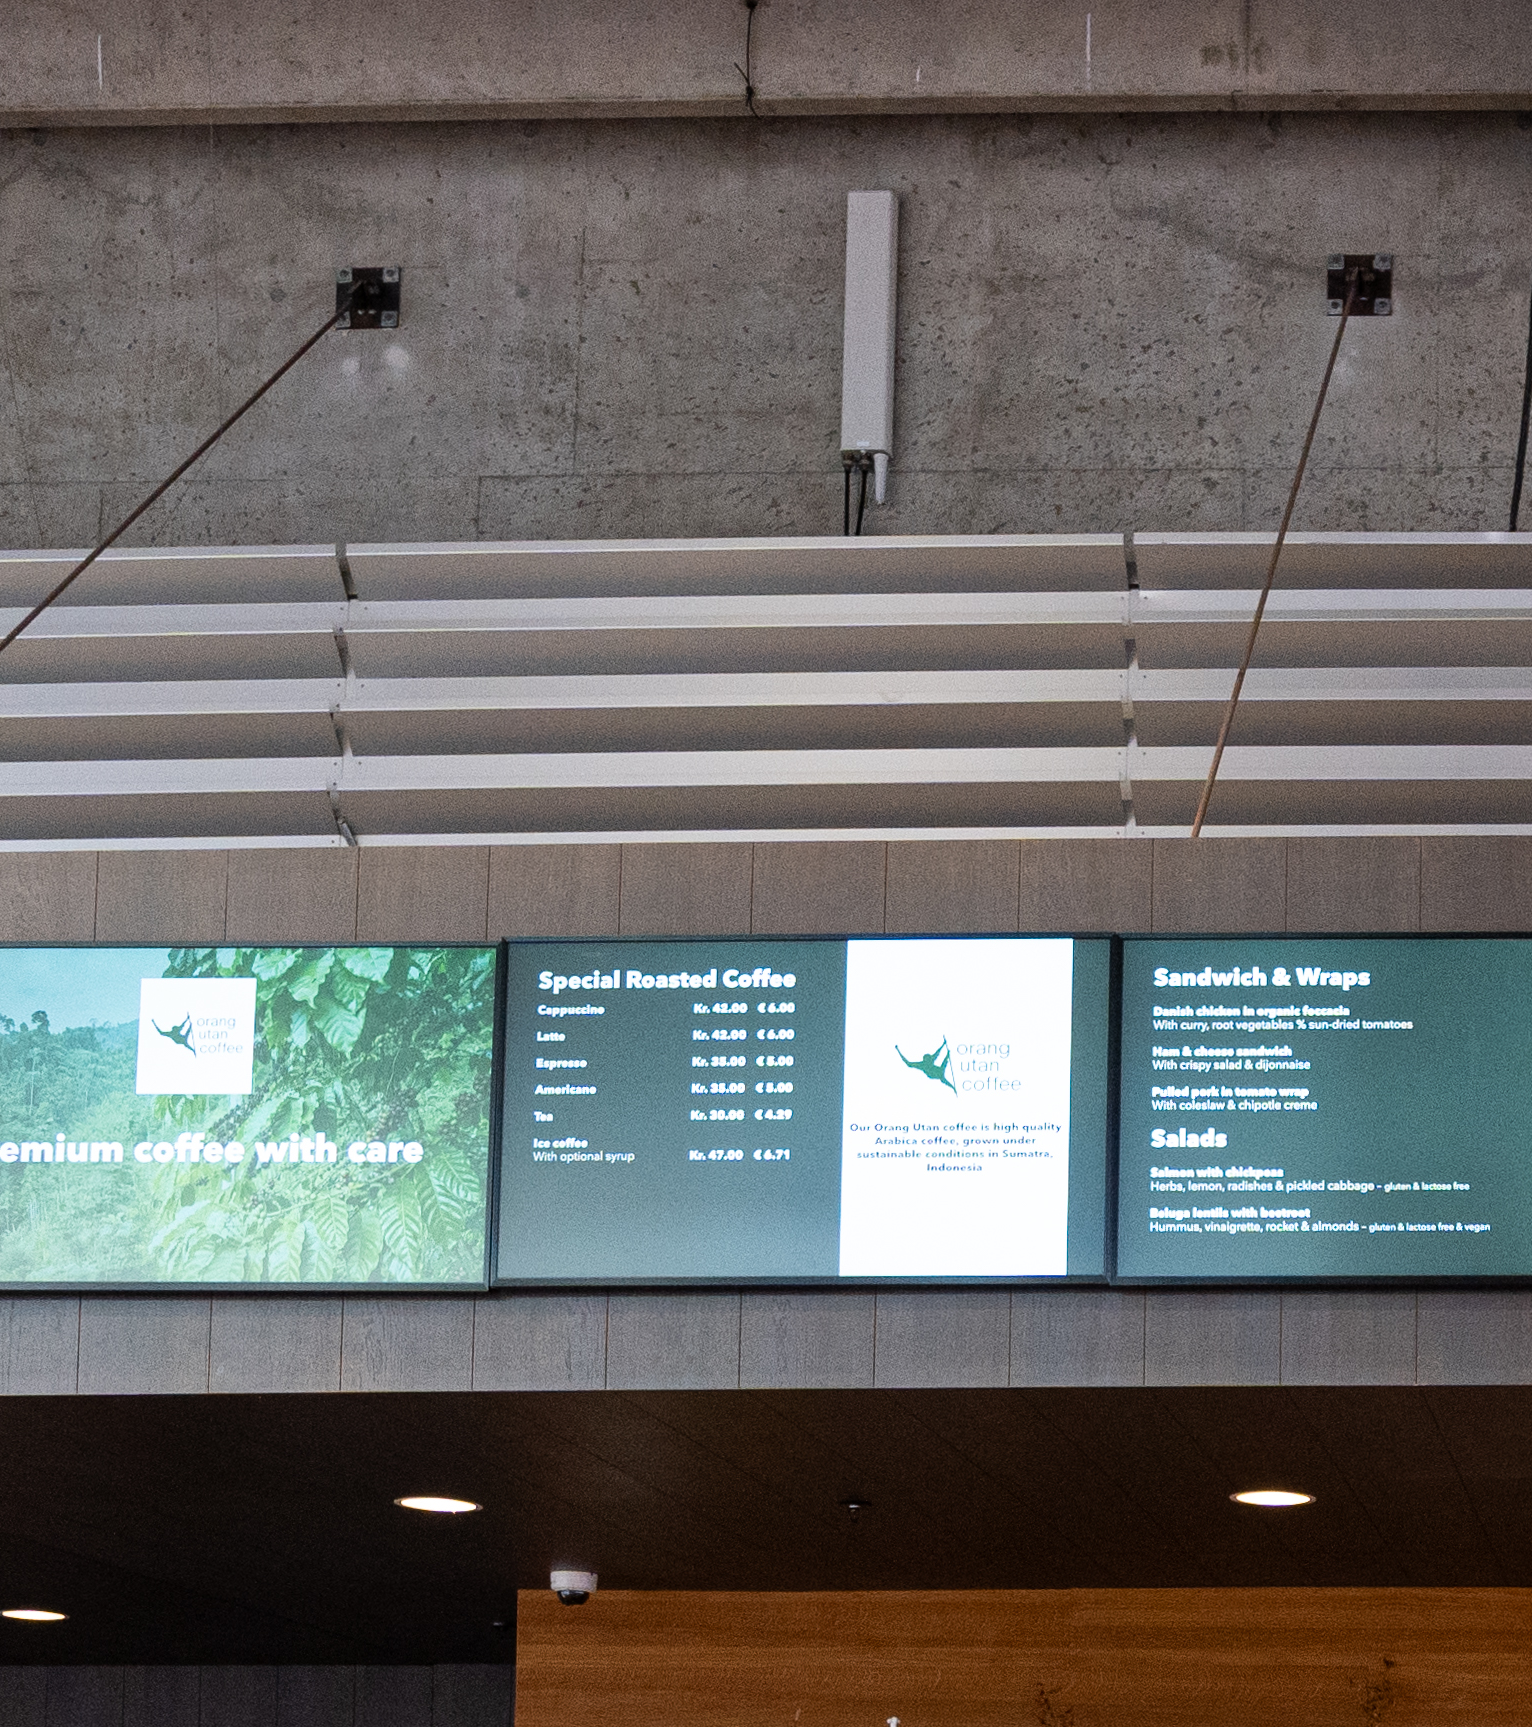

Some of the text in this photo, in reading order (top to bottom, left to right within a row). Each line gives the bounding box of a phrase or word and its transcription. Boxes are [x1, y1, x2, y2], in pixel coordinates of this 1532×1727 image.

[538, 967, 797, 995] Special Roasted Coffee
[1153, 966, 1371, 991] Sandwich & Wraps
[537, 1004, 605, 1018] Cappuccino
[196, 1017, 237, 1029] orang
[198, 1029, 228, 1040] utan
[536, 1031, 566, 1042] Latte
[199, 1042, 244, 1053] coffee
[956, 1043, 1011, 1059] orang
[536, 1057, 588, 1071] Espresso
[960, 1059, 999, 1072] utan
[534, 1083, 597, 1095] Americano
[962, 1077, 1022, 1092] coffee
[533, 1111, 554, 1122] Tea
[849, 1122, 1062, 1134] Our Orang Utan coffee is high quality
[533, 1137, 589, 1149] Ice coffee
[874, 1135, 1036, 1148] Arabica coffee, grown under
[1150, 1127, 1228, 1148] Salads
[134, 1132, 245, 1163] coffee
[254, 1132, 337, 1163] with
[348, 1141, 423, 1163] care
[857, 1148, 1055, 1159] sustainable conditions in Sumatra,
[532, 1149, 636, 1164] With optional syrup
[689, 1149, 744, 1161] Kr. 47.00
[926, 1162, 983, 1172] Indonesia
